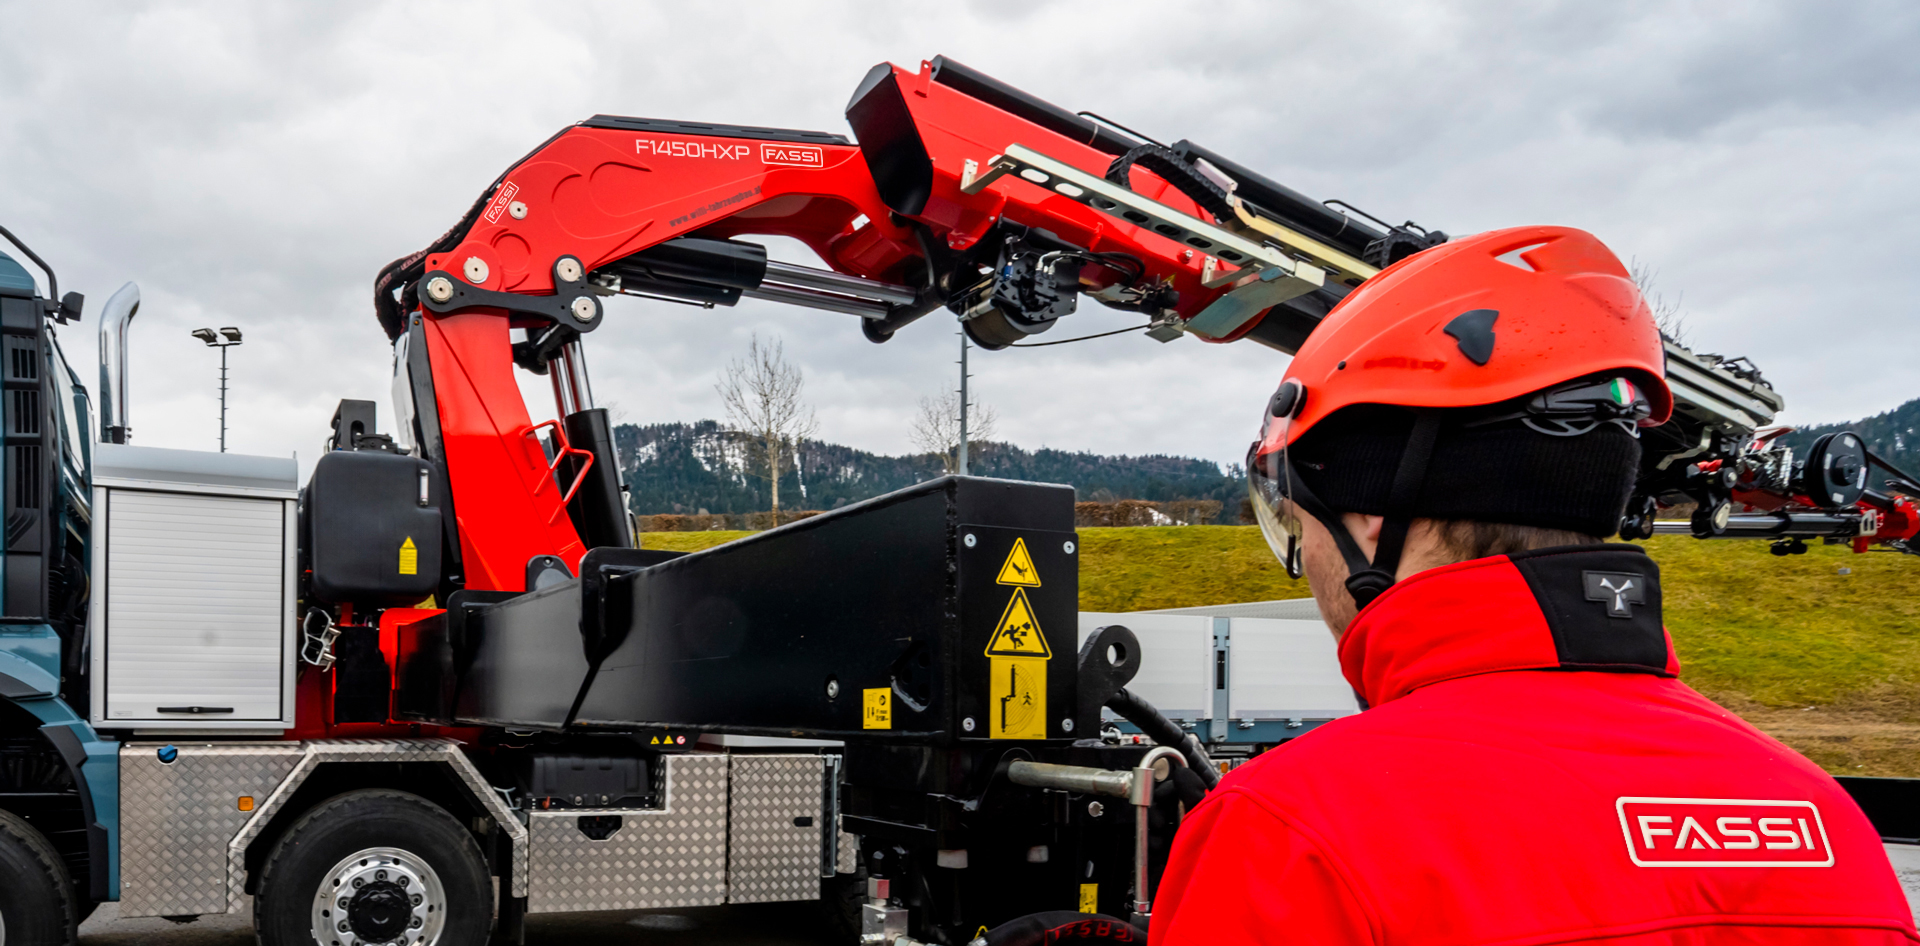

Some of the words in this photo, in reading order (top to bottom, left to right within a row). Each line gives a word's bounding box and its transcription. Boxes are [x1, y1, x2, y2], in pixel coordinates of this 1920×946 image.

[635, 139, 750, 160] F1450HXP
[765, 149, 819, 163] FASSI
[488, 185, 515, 220] FASSI
[1637, 815, 1816, 850] FASSI
[1054, 921, 1129, 941] FASSI
